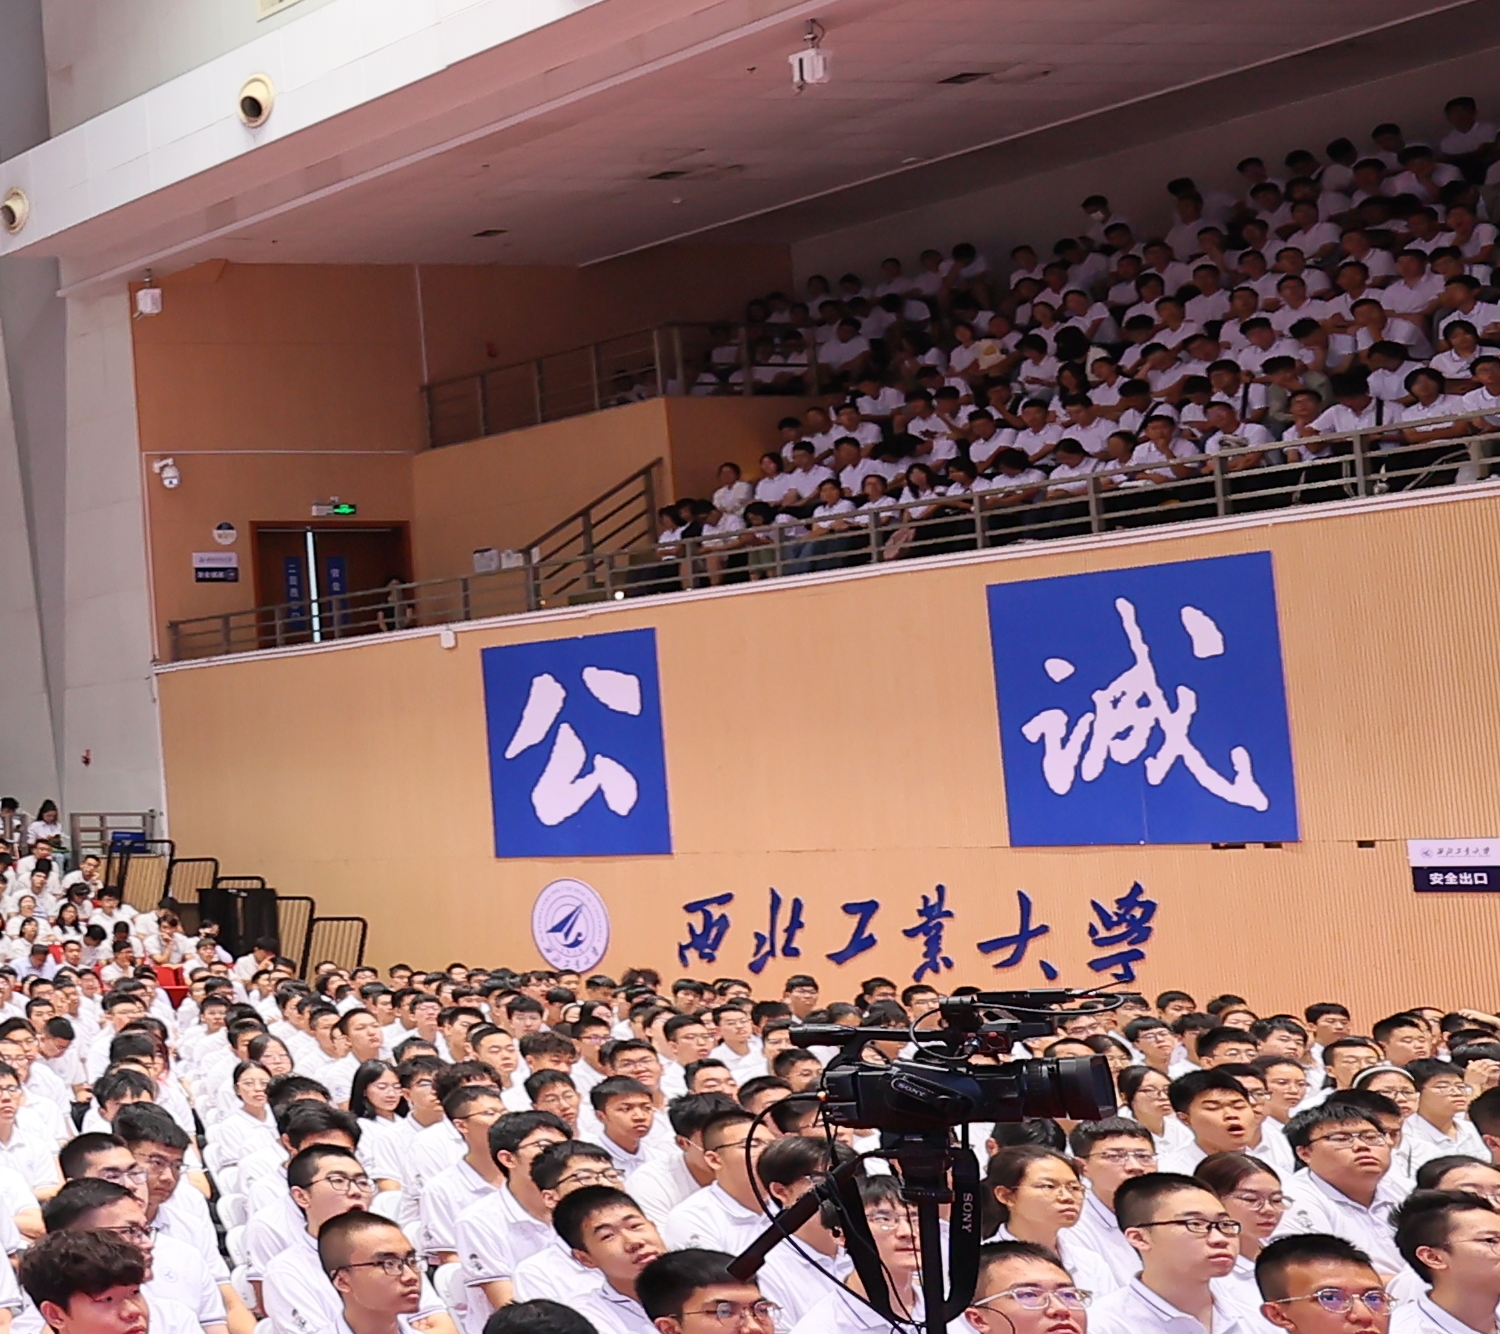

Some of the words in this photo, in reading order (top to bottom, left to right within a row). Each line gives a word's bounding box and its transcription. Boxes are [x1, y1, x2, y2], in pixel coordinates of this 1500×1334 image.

[504, 666, 642, 826] 公
[1429, 872, 1488, 885] 安全出口
[896, 1082, 926, 1097] SONY
[962, 1192, 974, 1234] SONY
